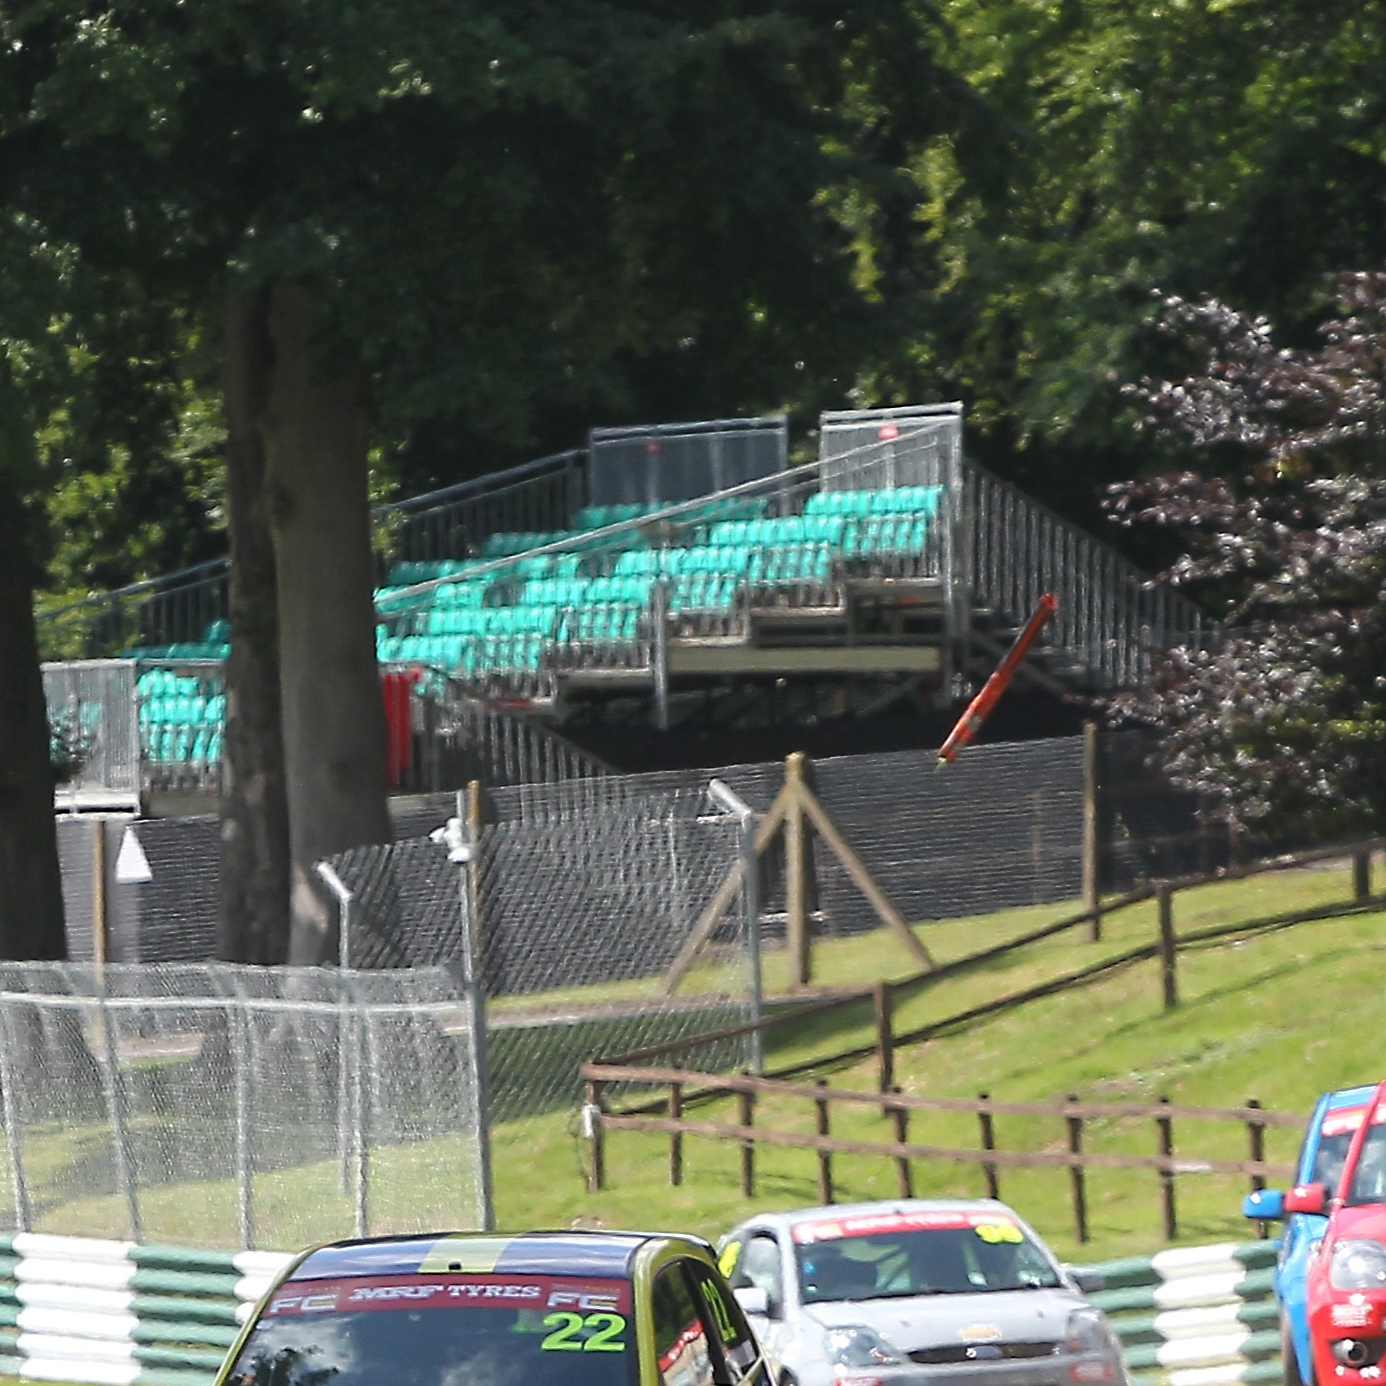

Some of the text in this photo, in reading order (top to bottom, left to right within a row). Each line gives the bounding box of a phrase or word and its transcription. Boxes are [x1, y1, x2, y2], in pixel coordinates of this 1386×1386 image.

[348, 1284, 444, 1301] MRF
[447, 1284, 542, 1298] TYRES
[540, 1312, 628, 1351] 22
